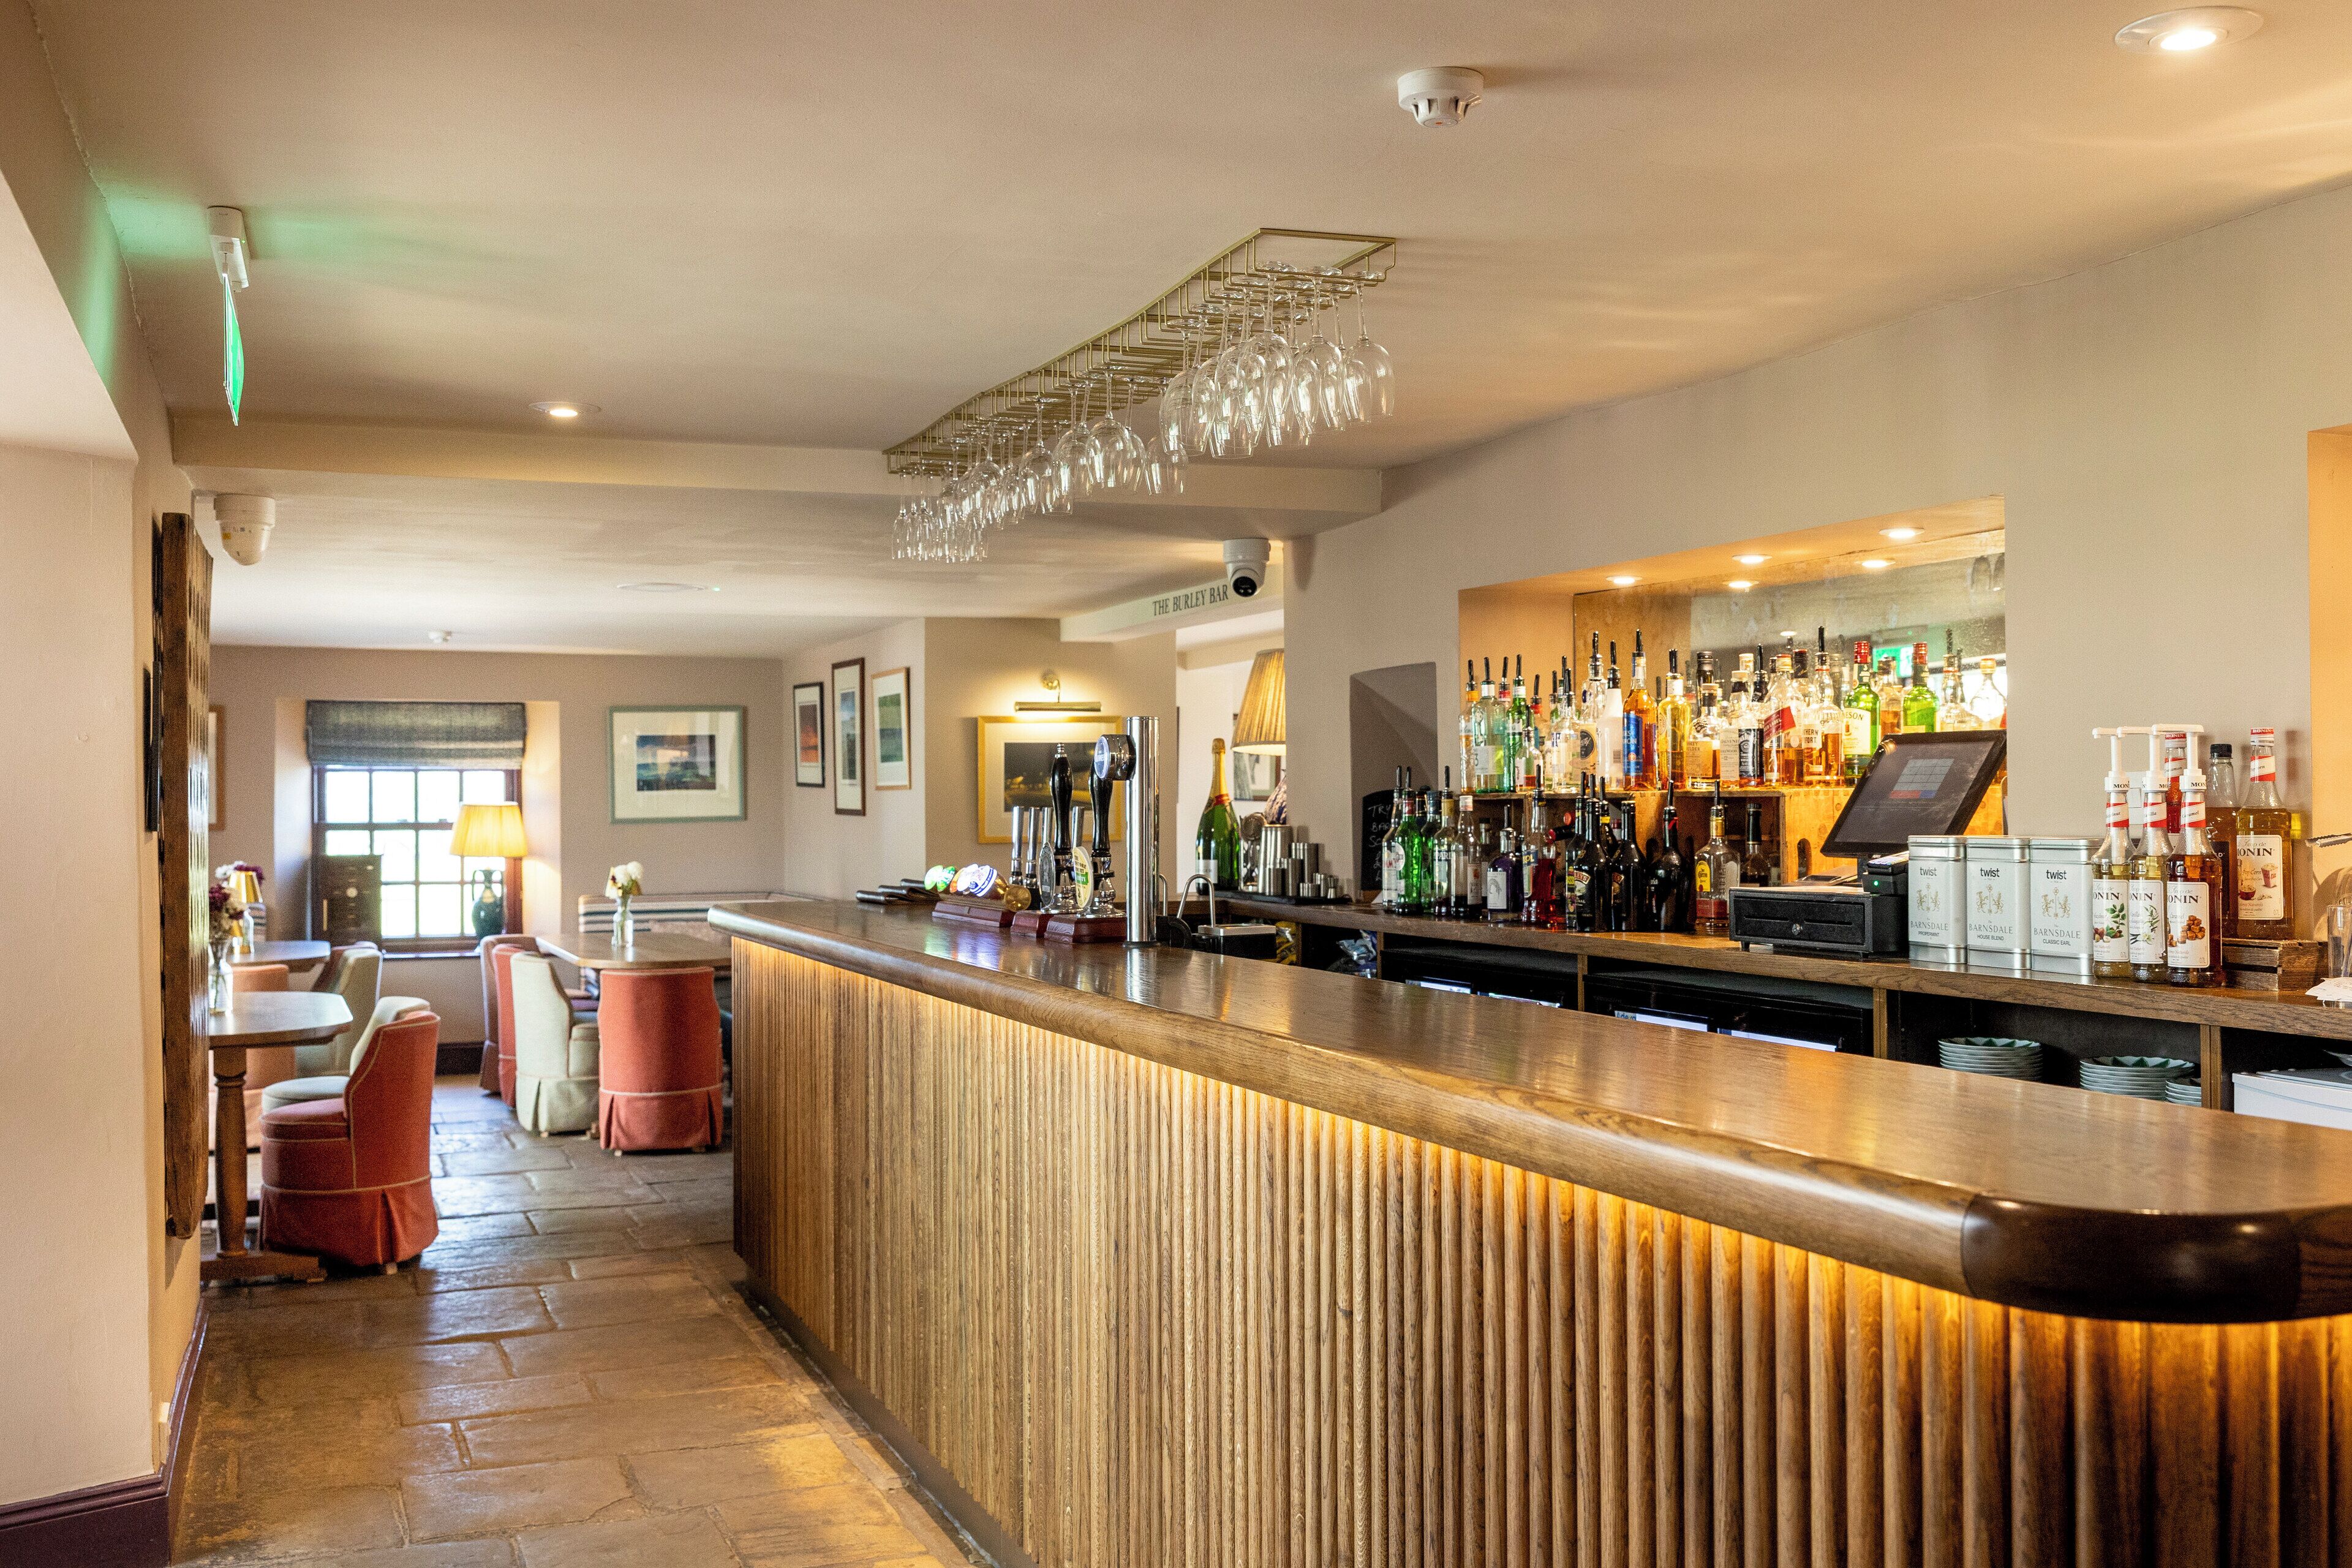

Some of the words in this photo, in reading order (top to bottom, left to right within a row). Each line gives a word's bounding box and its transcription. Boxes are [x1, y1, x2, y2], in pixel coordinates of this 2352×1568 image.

[1152, 598, 1170, 616] THE
[1172, 589, 1207, 612] BURLEY
[1209, 584, 1229, 604] BAR
[1845, 711, 1864, 721] ESON
[1920, 866, 1937, 876] twist
[1980, 867, 2000, 877] twist
[2046, 869, 2067, 880] twist
[2094, 892, 2120, 900] ONIN
[2130, 892, 2154, 901] NIN
[2168, 895, 2199, 903] ONIN
[1910, 920, 1949, 931] BARNSDALE
[1969, 923, 2013, 934] BARNSDALE
[2034, 927, 2081, 939] BARNSDALE
